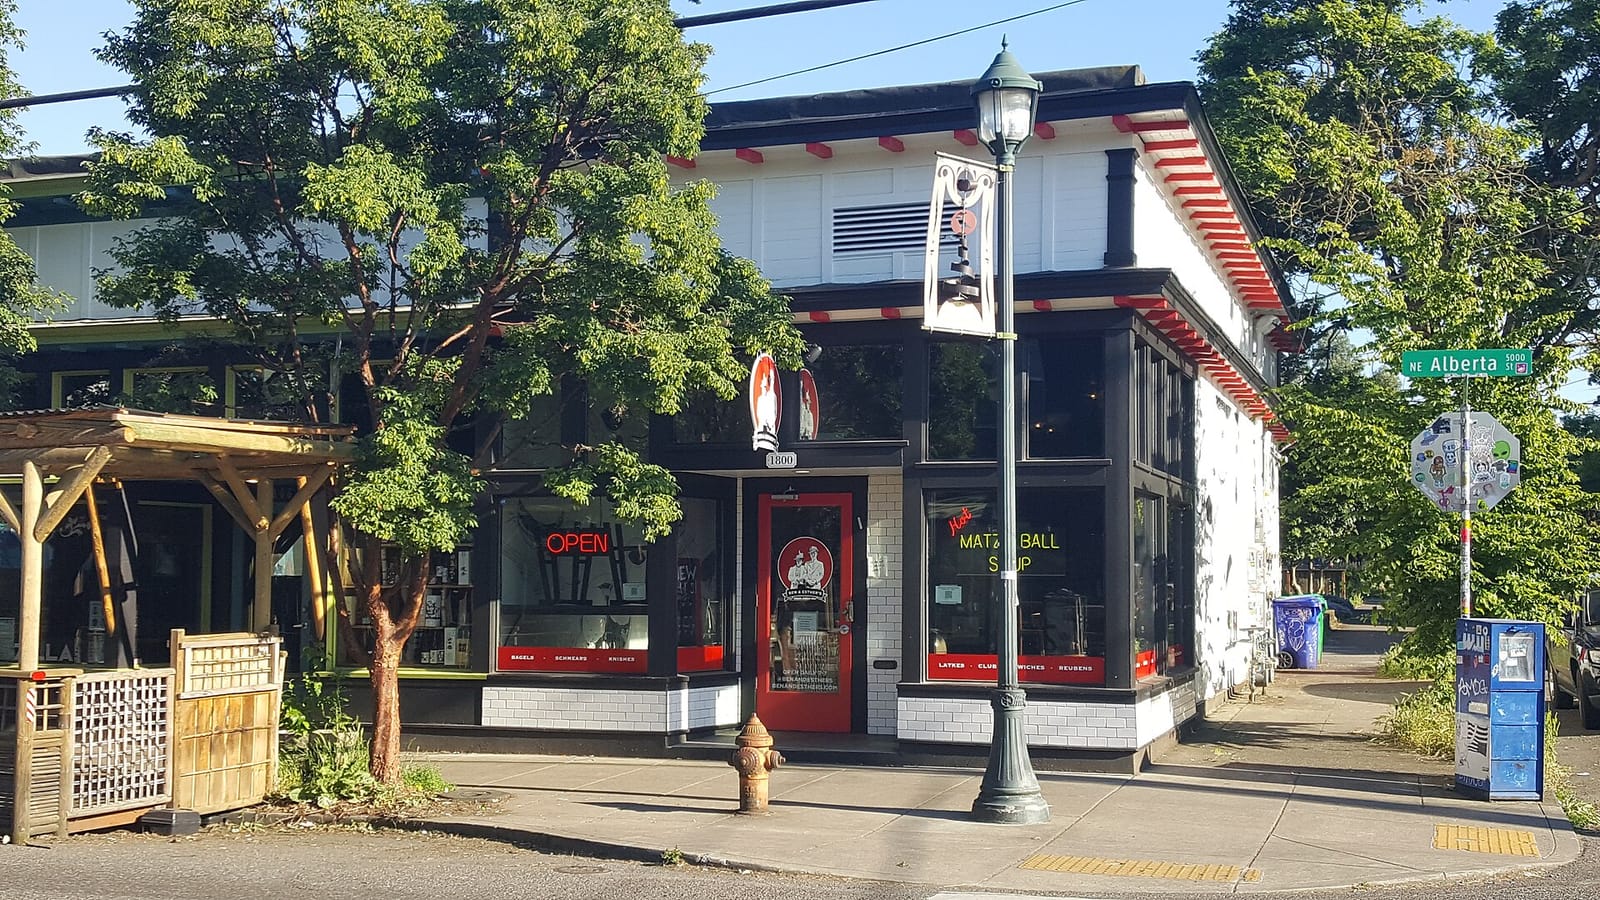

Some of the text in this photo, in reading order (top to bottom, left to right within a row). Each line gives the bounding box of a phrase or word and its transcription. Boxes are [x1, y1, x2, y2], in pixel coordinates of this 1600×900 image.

[1409, 355, 1514, 372] NE Alberta St
[1505, 353, 1526, 362] 5000
[770, 455, 793, 465] 1800
[948, 506, 973, 537] Hot
[546, 532, 608, 553] OPEN
[960, 533, 1060, 549] MATZ BALL
[989, 556, 1031, 572] SUP
